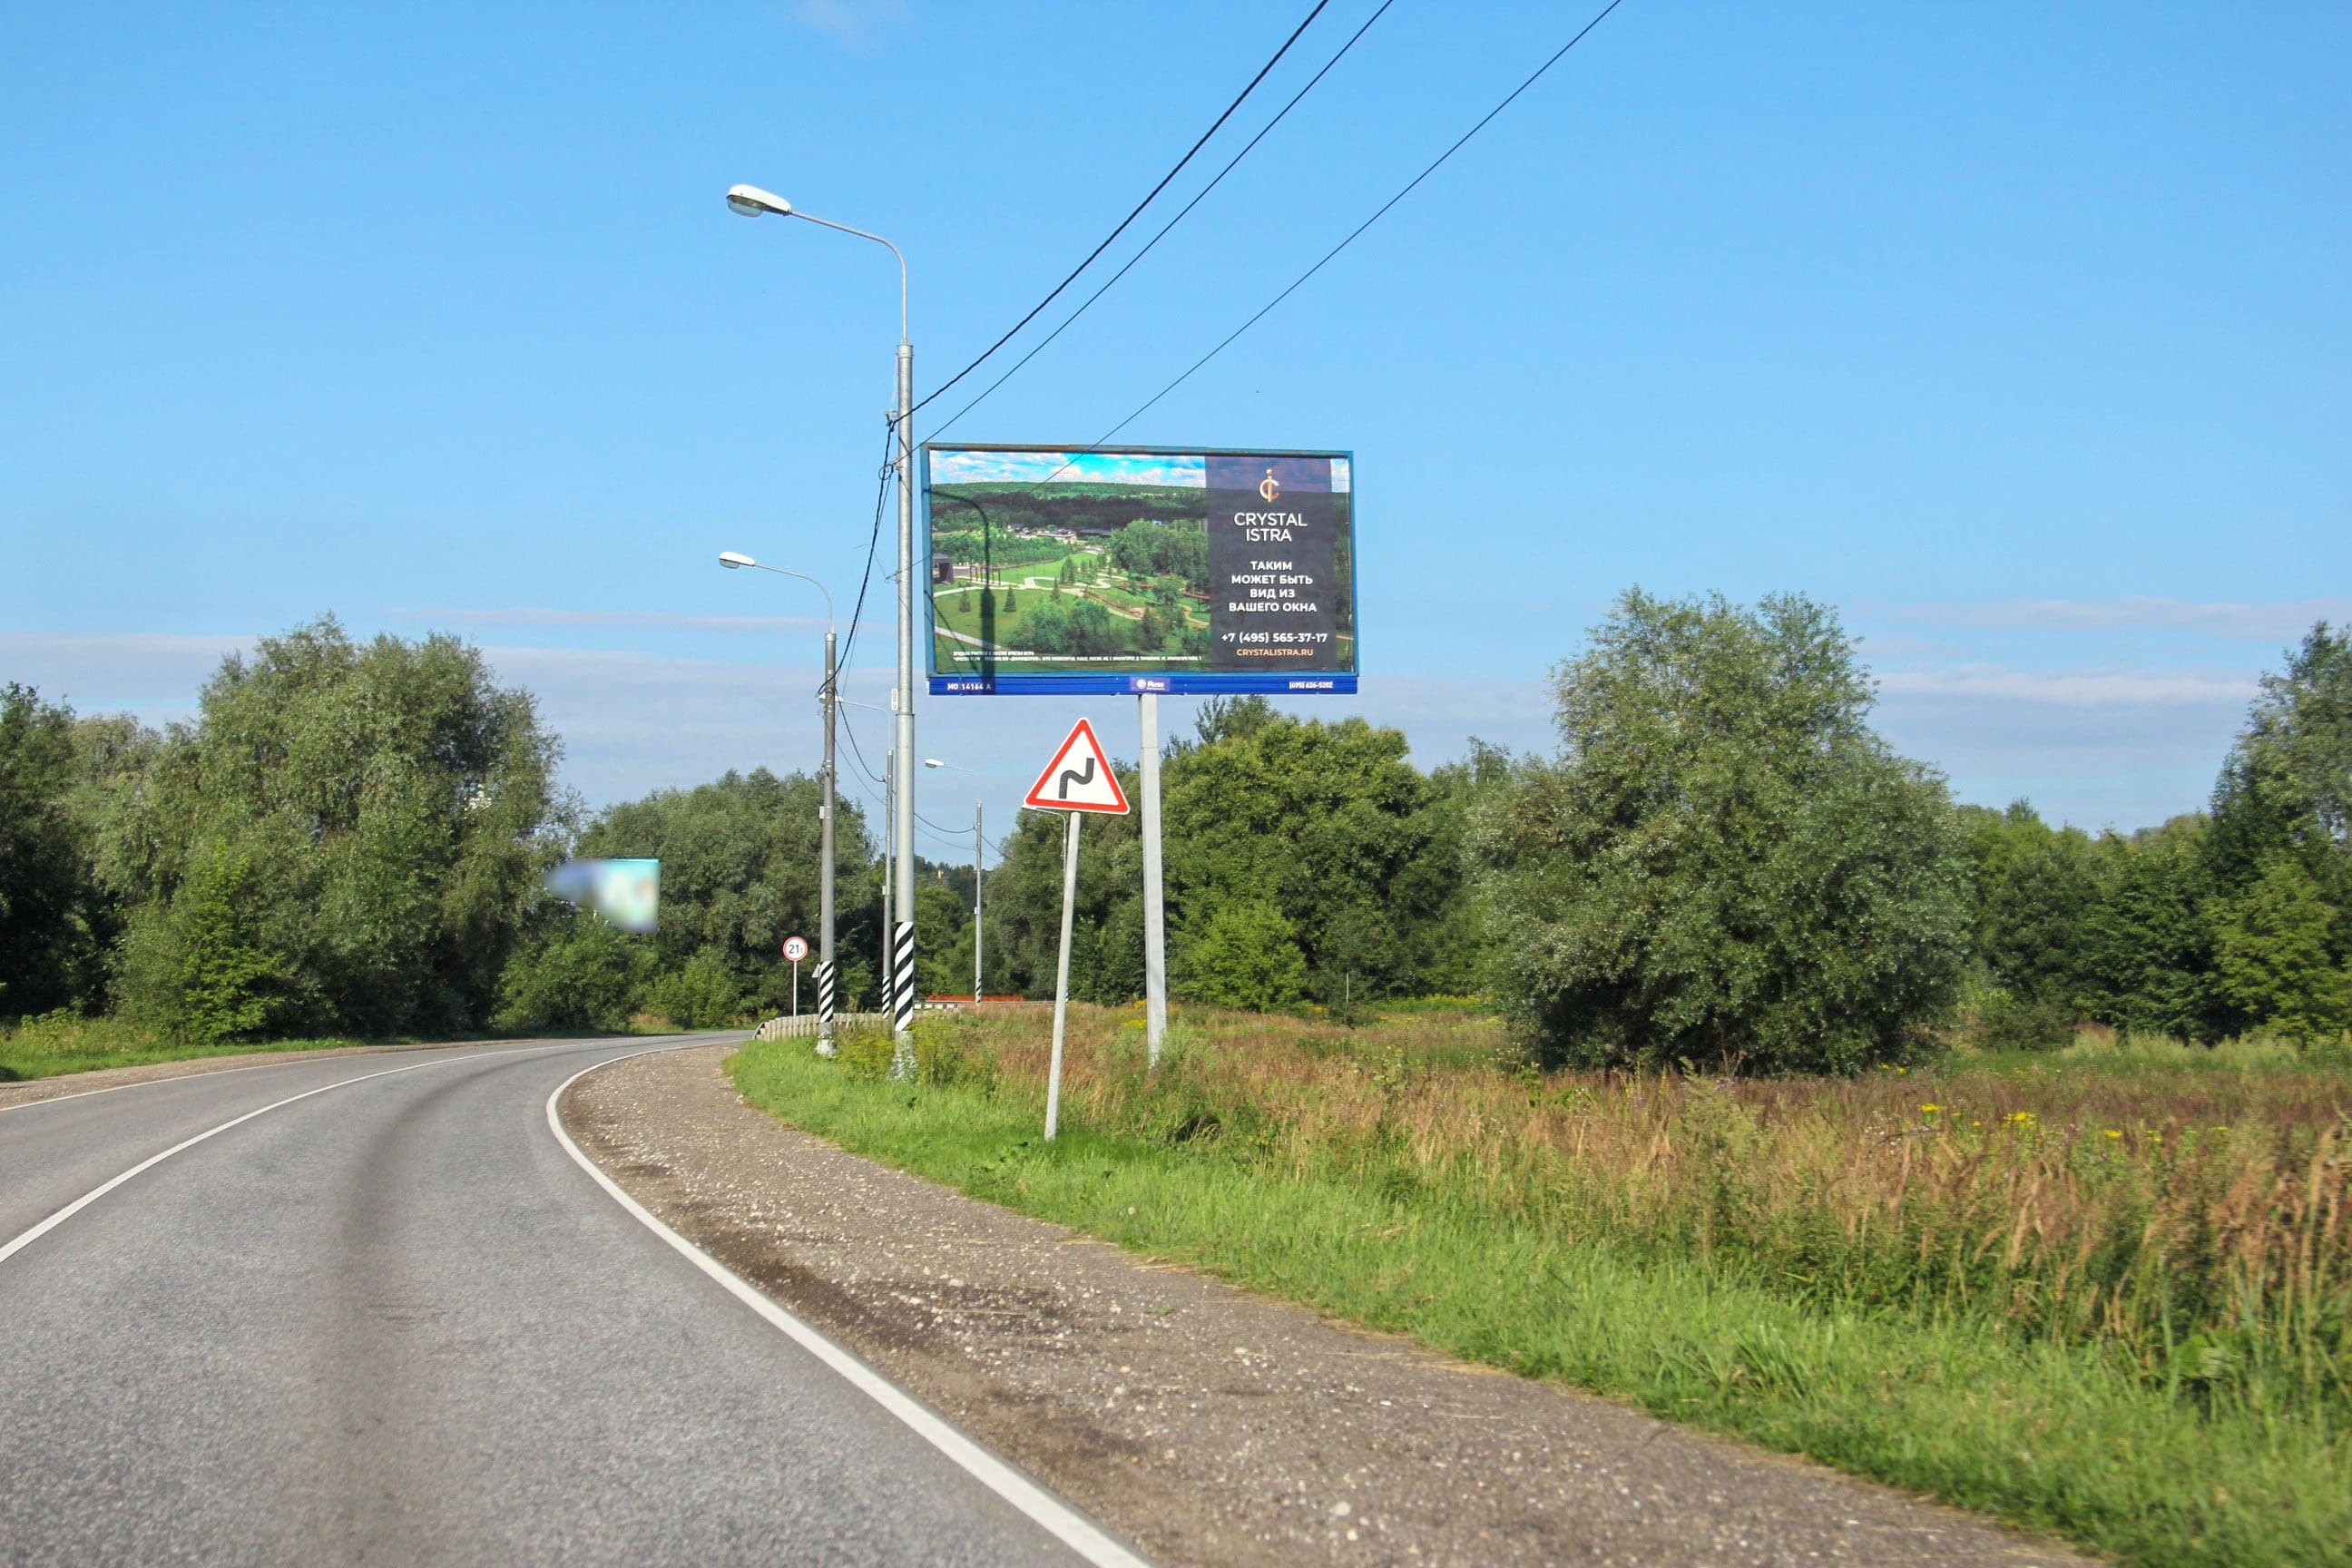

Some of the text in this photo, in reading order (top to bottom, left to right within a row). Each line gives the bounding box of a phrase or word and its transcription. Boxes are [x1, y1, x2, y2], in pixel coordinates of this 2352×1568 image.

[1234, 513, 1308, 526] CRYSTAL
[1246, 528, 1292, 542] ISTRA
[1250, 562, 1292, 570] ТАКИМ
[1231, 575, 1313, 584] МОЖЕТ БЫТЬ
[1250, 589, 1295, 599] ВИД ИЗ
[1229, 603, 1317, 612] ВАШЕГО ОКНА
[1221, 632, 1328, 643] +7 (495) 565-37-17
[1236, 648, 1314, 656] CRYSTALISTRA.RU
